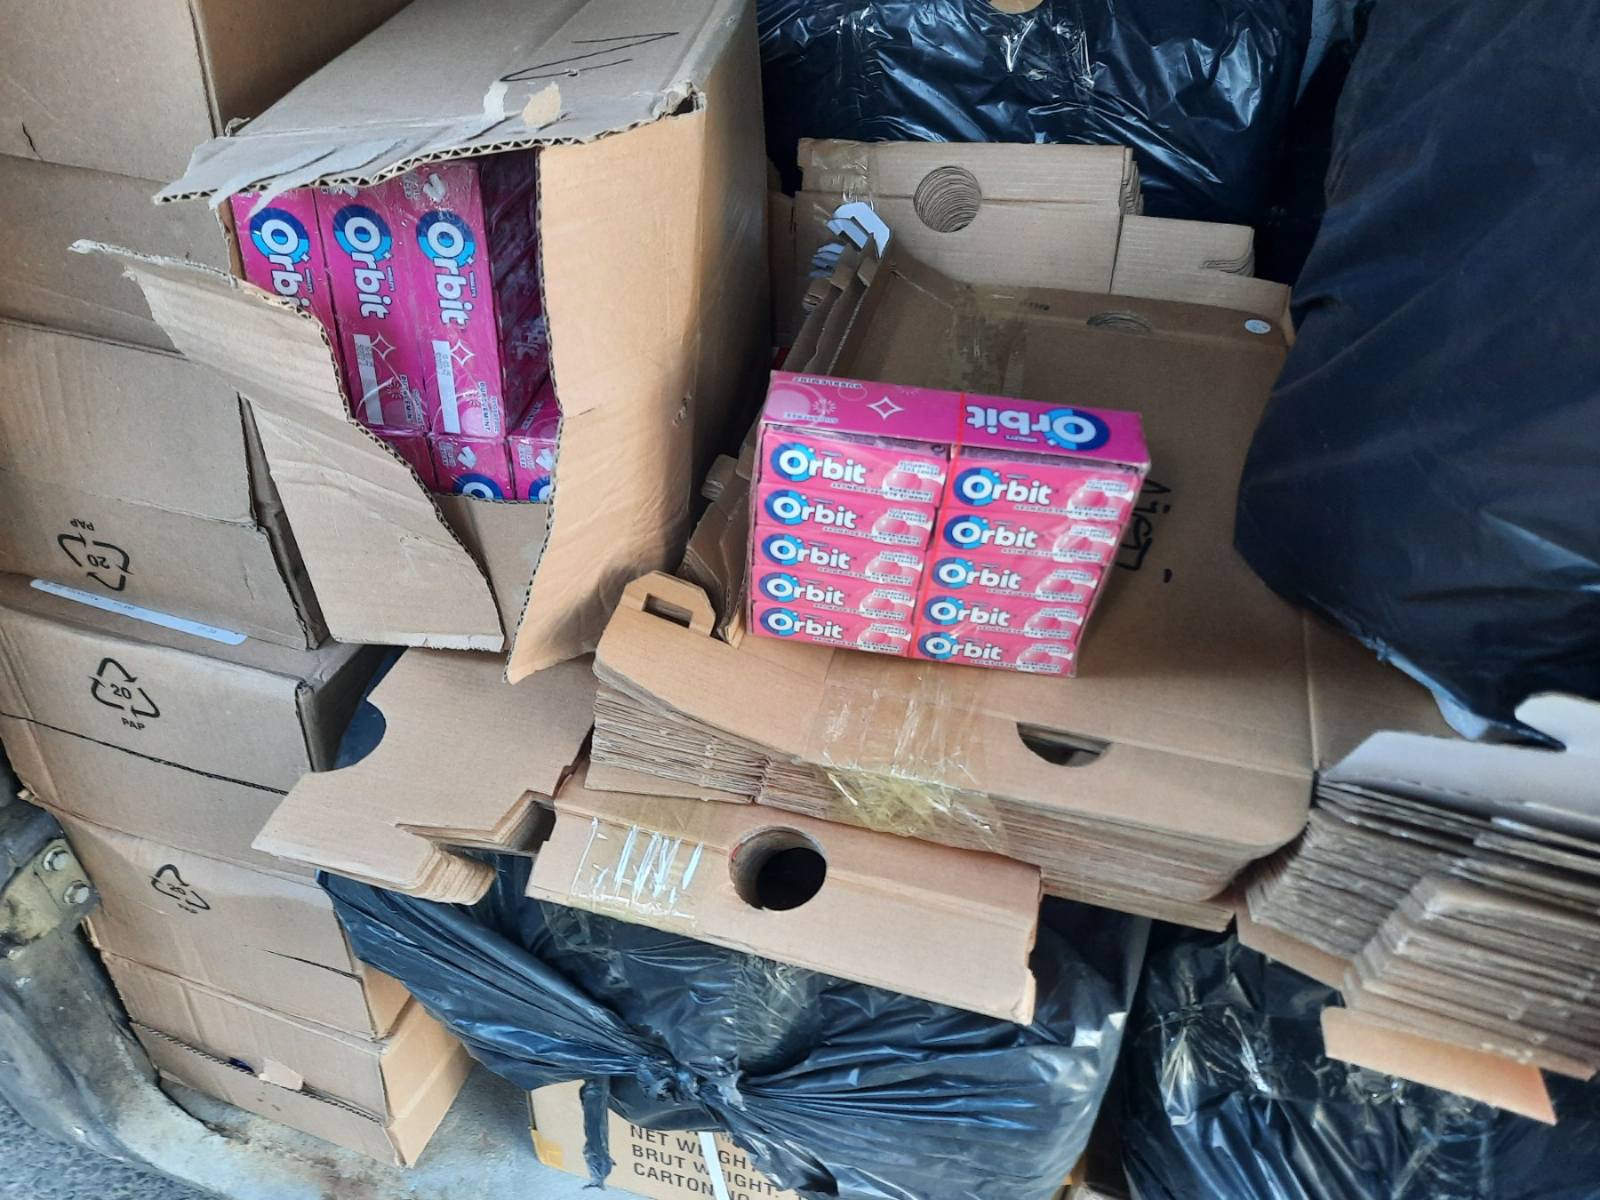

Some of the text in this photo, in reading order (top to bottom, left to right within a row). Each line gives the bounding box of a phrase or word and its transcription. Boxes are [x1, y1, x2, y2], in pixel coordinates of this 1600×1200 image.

[343, 216, 392, 319] Orbit
[427, 221, 474, 325] Orbit
[966, 405, 1097, 444] Orbit
[779, 448, 867, 484] Orbit
[962, 474, 1052, 505] Orbit
[70, 518, 95, 532] PAP
[772, 496, 858, 529] Orbit
[951, 521, 1039, 549] Orbit
[87, 554, 110, 569] 20
[769, 537, 852, 569] Orbit
[766, 575, 846, 606] Orbit
[938, 563, 1023, 590] Orbit
[767, 610, 844, 639] Orbit
[930, 601, 1010, 627] Orbit
[925, 635, 1003, 660] Orbit
[110, 683, 132, 699] 20
[121, 717, 146, 730] PAP
[630, 1124, 668, 1146] NET
[631, 1144, 779, 1198] BRUT WIGHT.
[633, 1162, 714, 1197] CARTON
